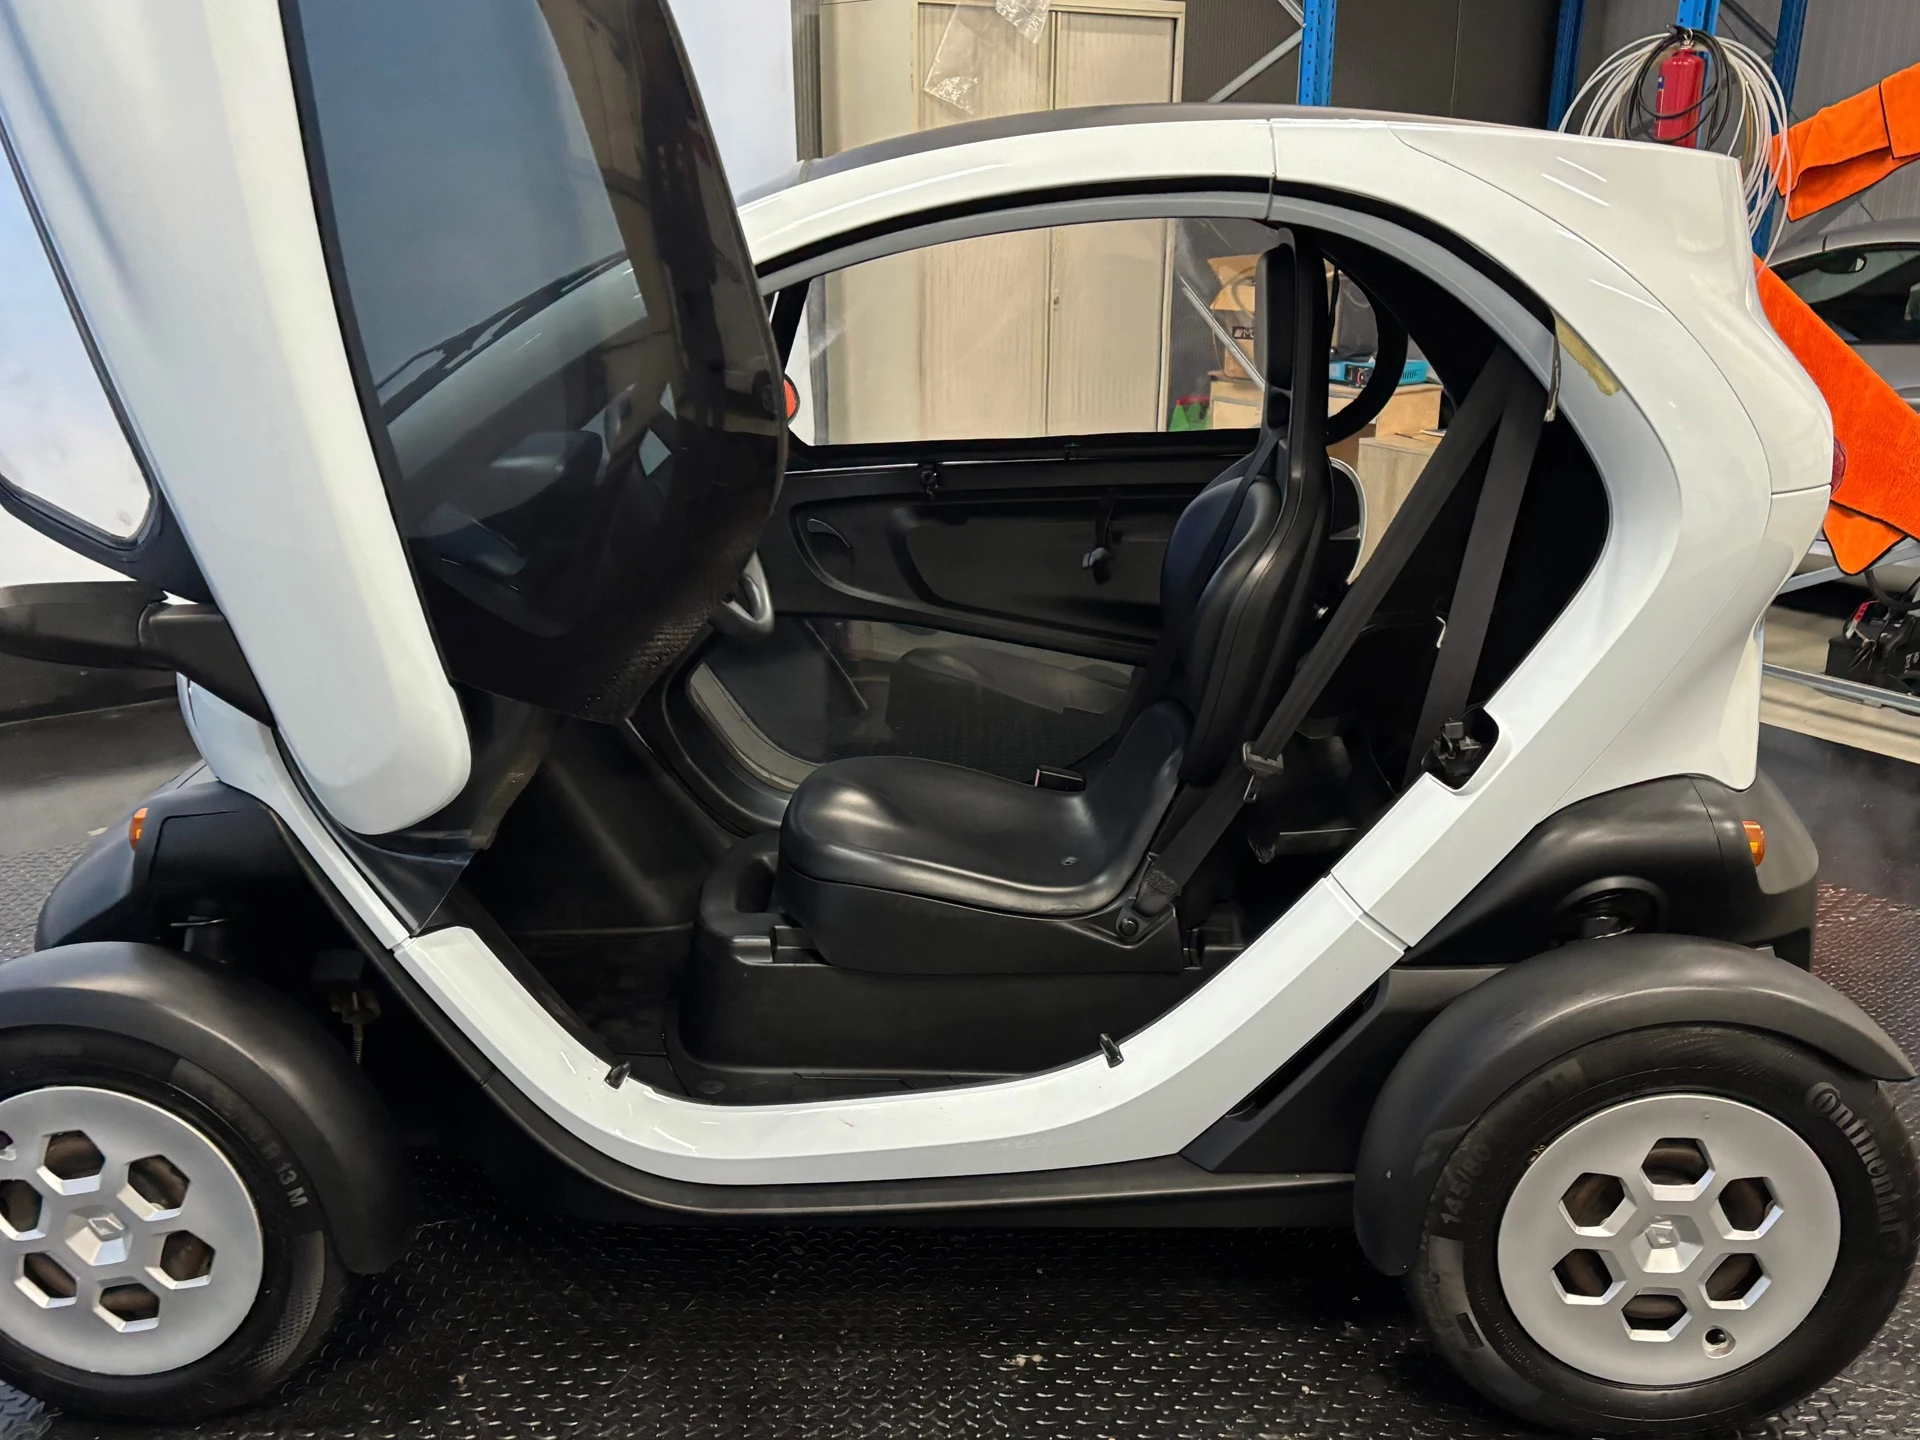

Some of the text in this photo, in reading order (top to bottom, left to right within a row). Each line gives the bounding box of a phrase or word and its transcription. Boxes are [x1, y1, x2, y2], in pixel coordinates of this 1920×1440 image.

[273, 1162, 298, 1186] 13
[286, 1186, 309, 1208] M
[1440, 1142, 1493, 1225] 145/80
[1804, 1081, 1908, 1234] Continental
